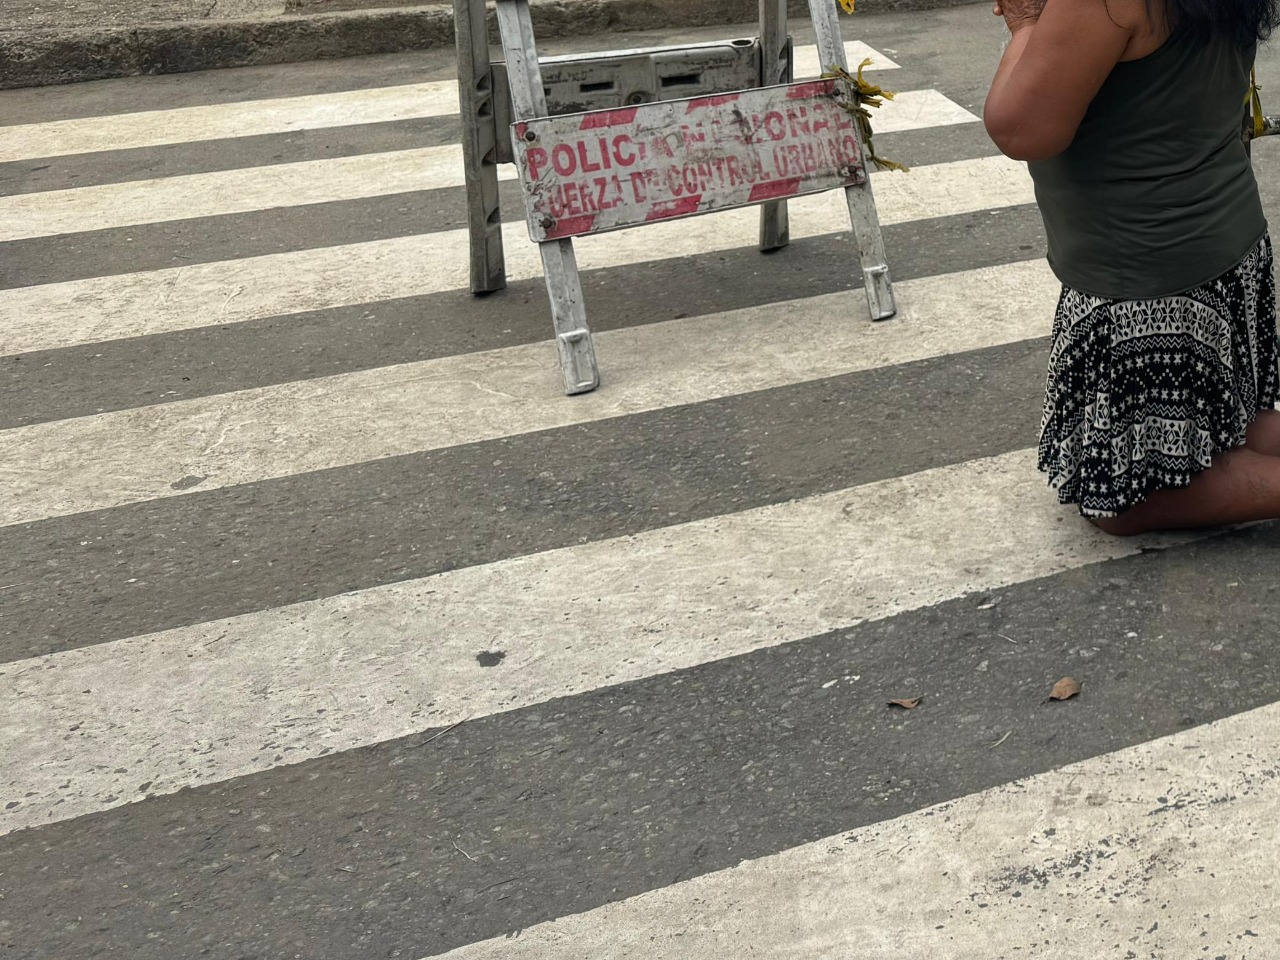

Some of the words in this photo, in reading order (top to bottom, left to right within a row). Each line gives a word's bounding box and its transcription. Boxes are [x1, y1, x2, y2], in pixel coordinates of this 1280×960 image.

[681, 103, 852, 146] NIONAL
[536, 173, 625, 218] UERZA
[773, 135, 857, 177] URBANO
